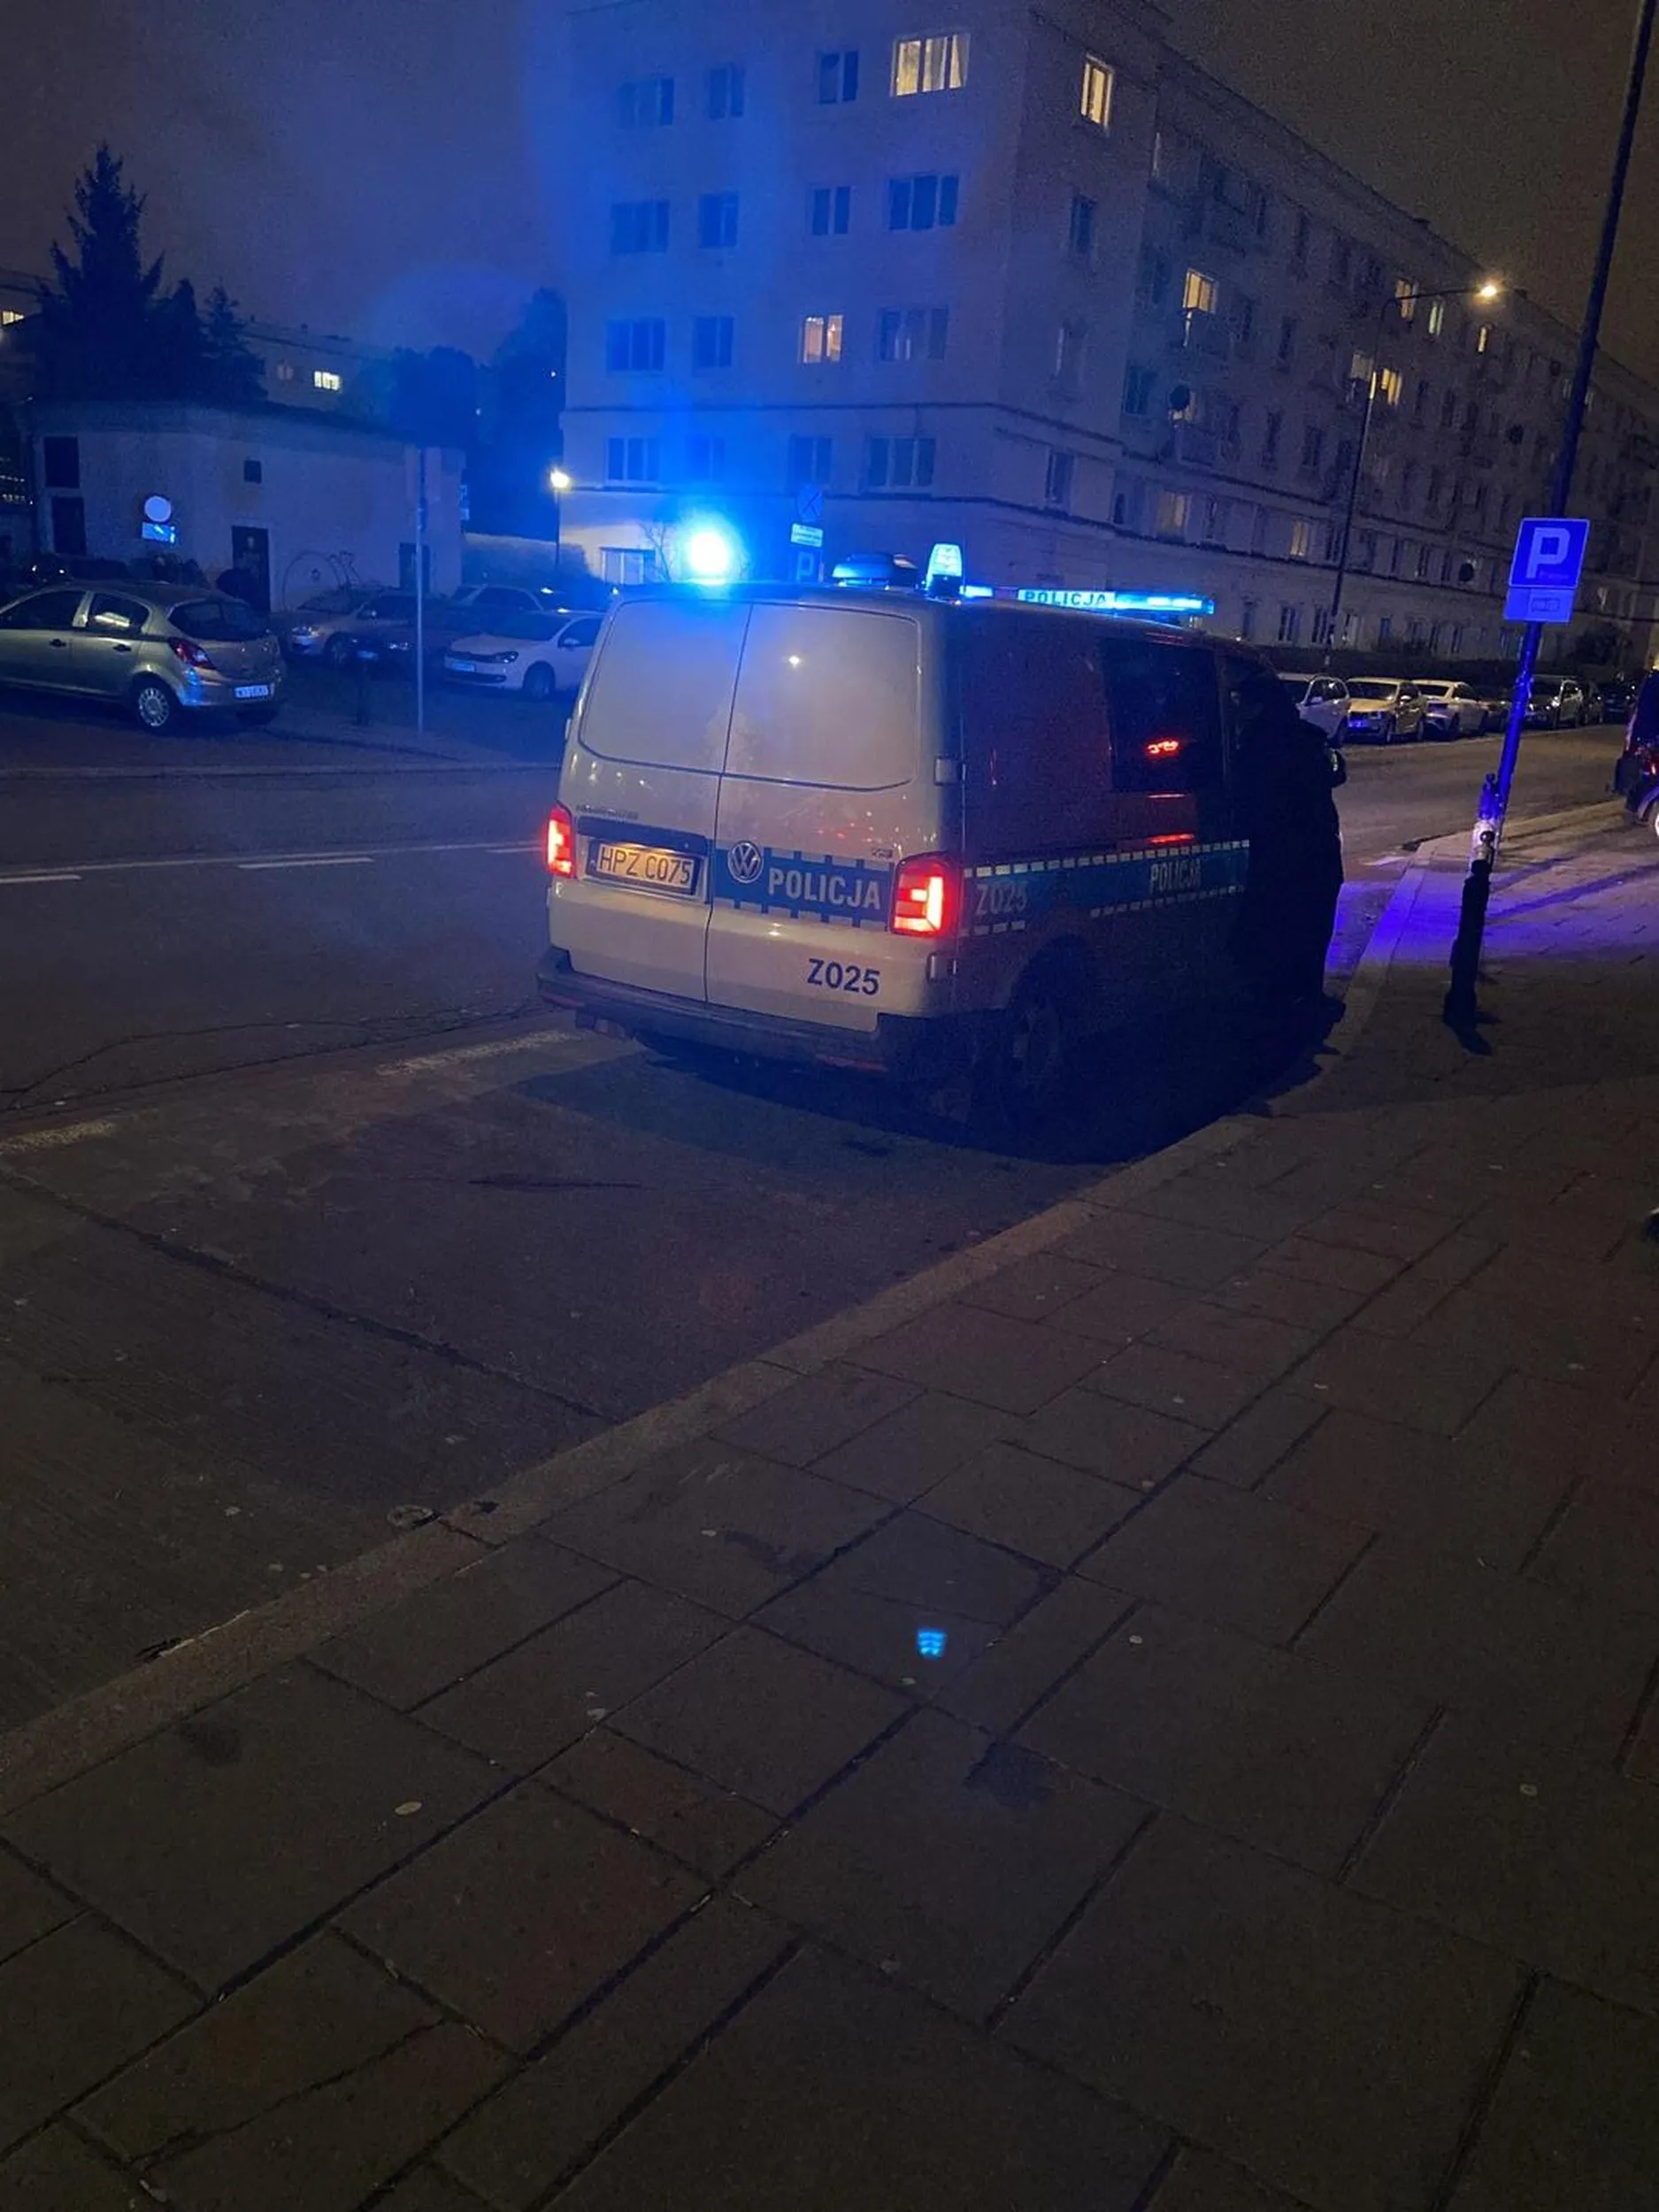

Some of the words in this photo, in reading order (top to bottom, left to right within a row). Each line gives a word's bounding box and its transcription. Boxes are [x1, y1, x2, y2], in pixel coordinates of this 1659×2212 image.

[1525, 527, 1571, 579] P
[1025, 590, 1109, 608] POLICJA
[598, 846, 639, 876] HPZ
[645, 855, 692, 884] C075
[1148, 859, 1202, 896] POLICJA
[768, 867, 881, 911] POLICJA
[975, 881, 1028, 917] Z025
[806, 957, 881, 996] Z025
